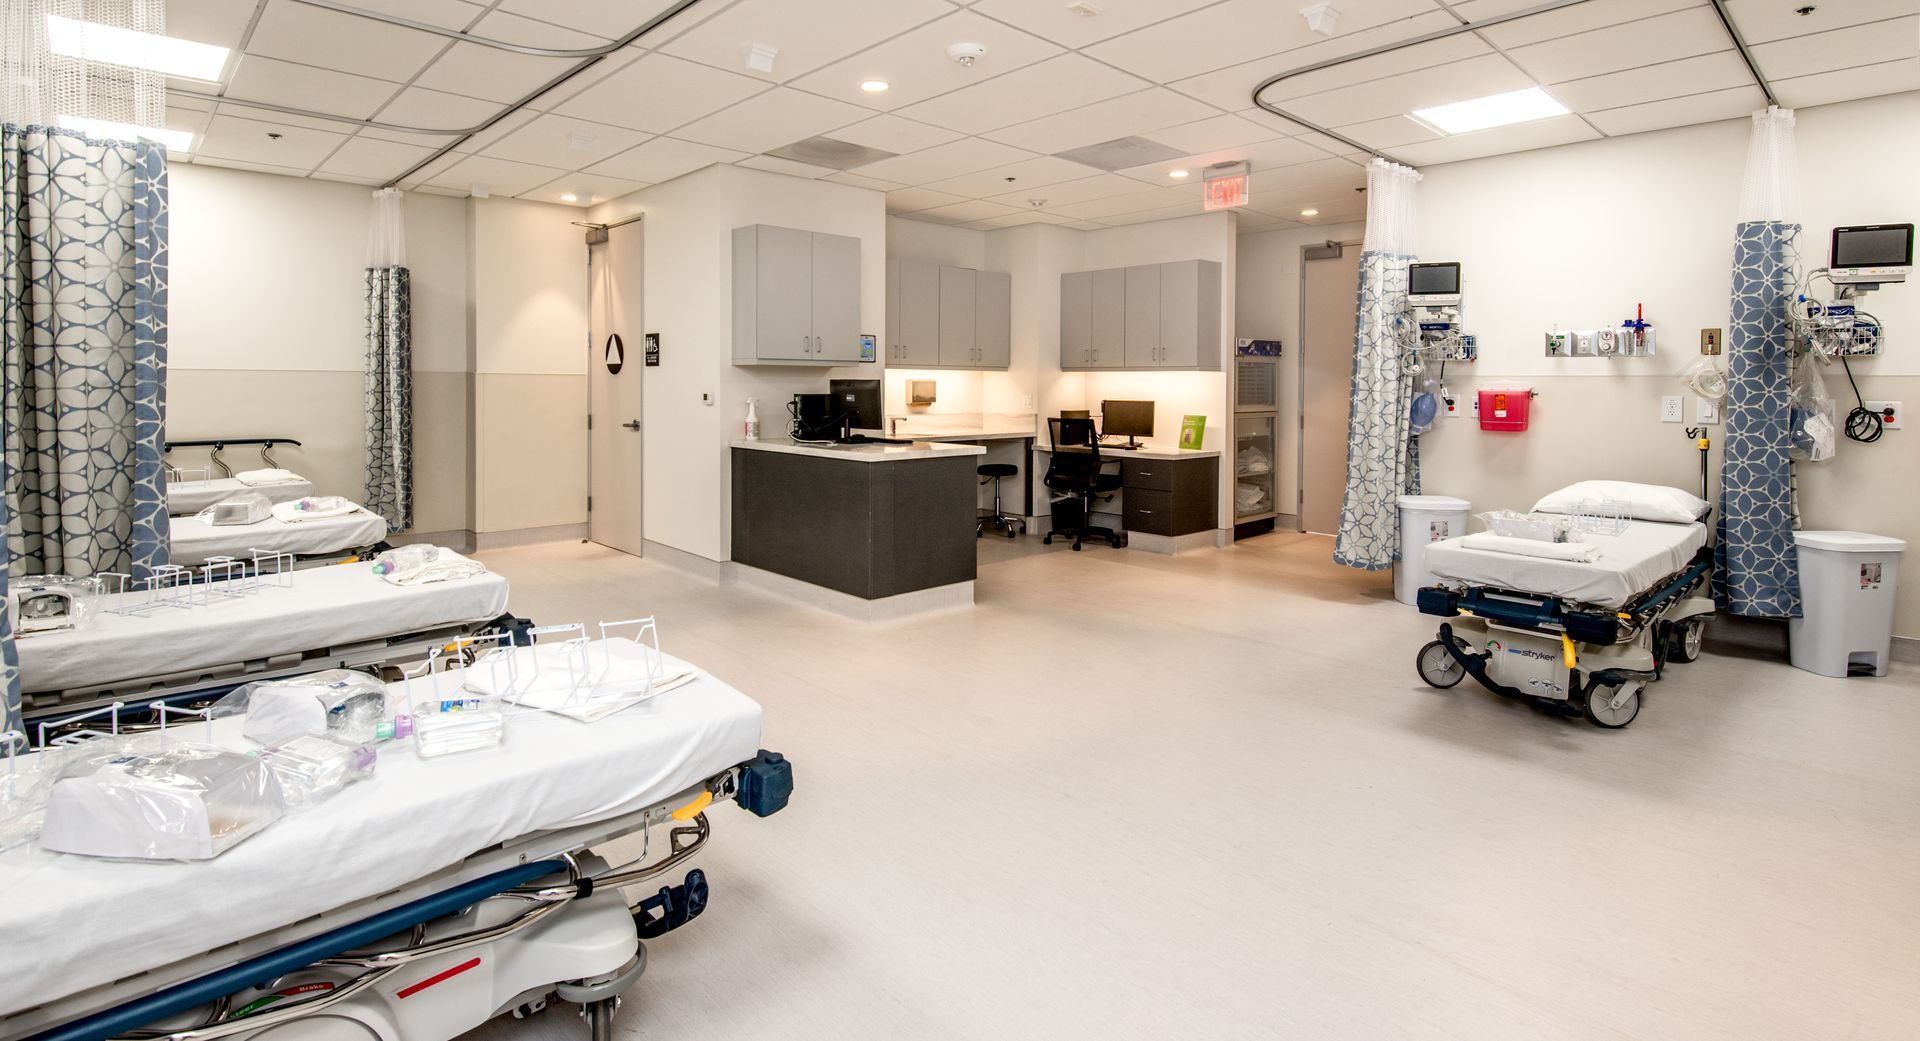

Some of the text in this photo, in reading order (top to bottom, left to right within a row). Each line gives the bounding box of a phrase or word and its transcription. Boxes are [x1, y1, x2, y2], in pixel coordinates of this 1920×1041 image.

[1211, 176, 1244, 208] EXIT
[1521, 649, 1556, 661] stryker
[299, 984, 324, 992] Brake
